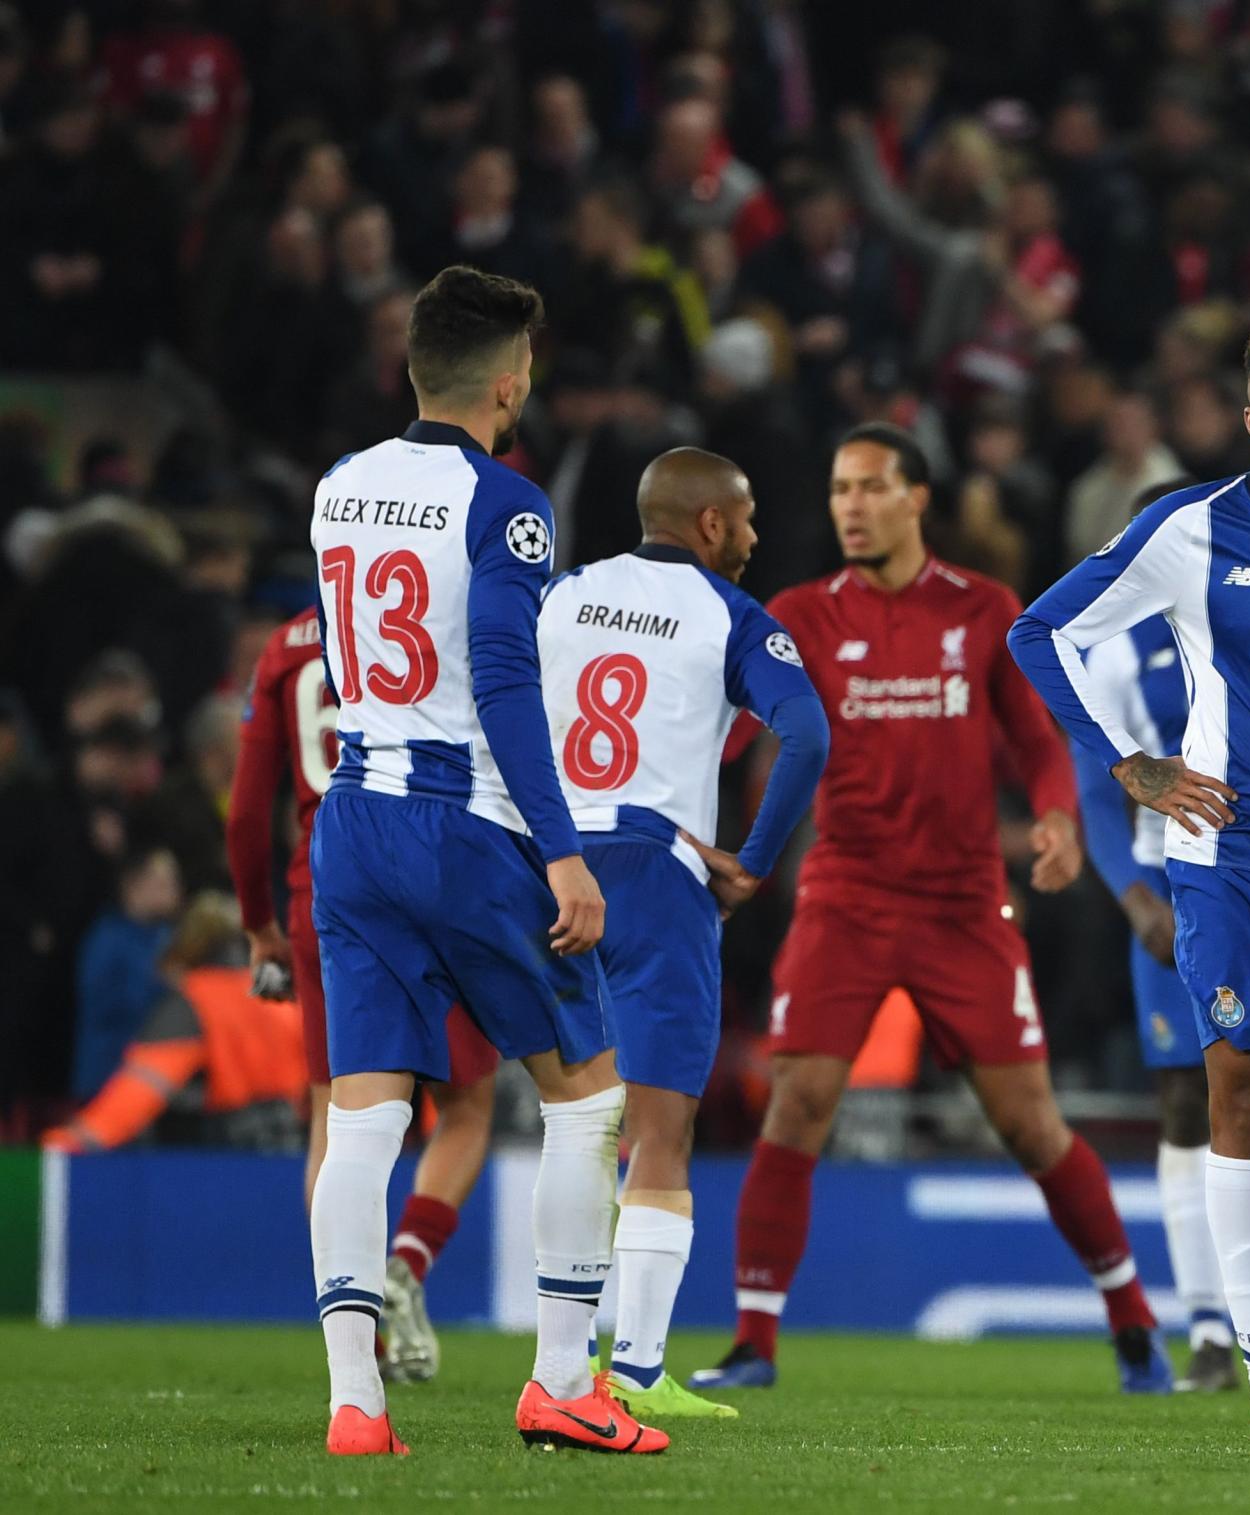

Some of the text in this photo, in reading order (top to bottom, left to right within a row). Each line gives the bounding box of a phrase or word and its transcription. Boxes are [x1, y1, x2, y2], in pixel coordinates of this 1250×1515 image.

[320, 497, 449, 531] ALEX TELLES
[321, 545, 439, 706] 13
[576, 604, 680, 640] BRAHIMI
[840, 697, 941, 720] Chartered
[848, 675, 941, 698] Standard
[296, 657, 340, 797] 6
[563, 653, 647, 790] 8
[1013, 965, 1038, 1024] 4
